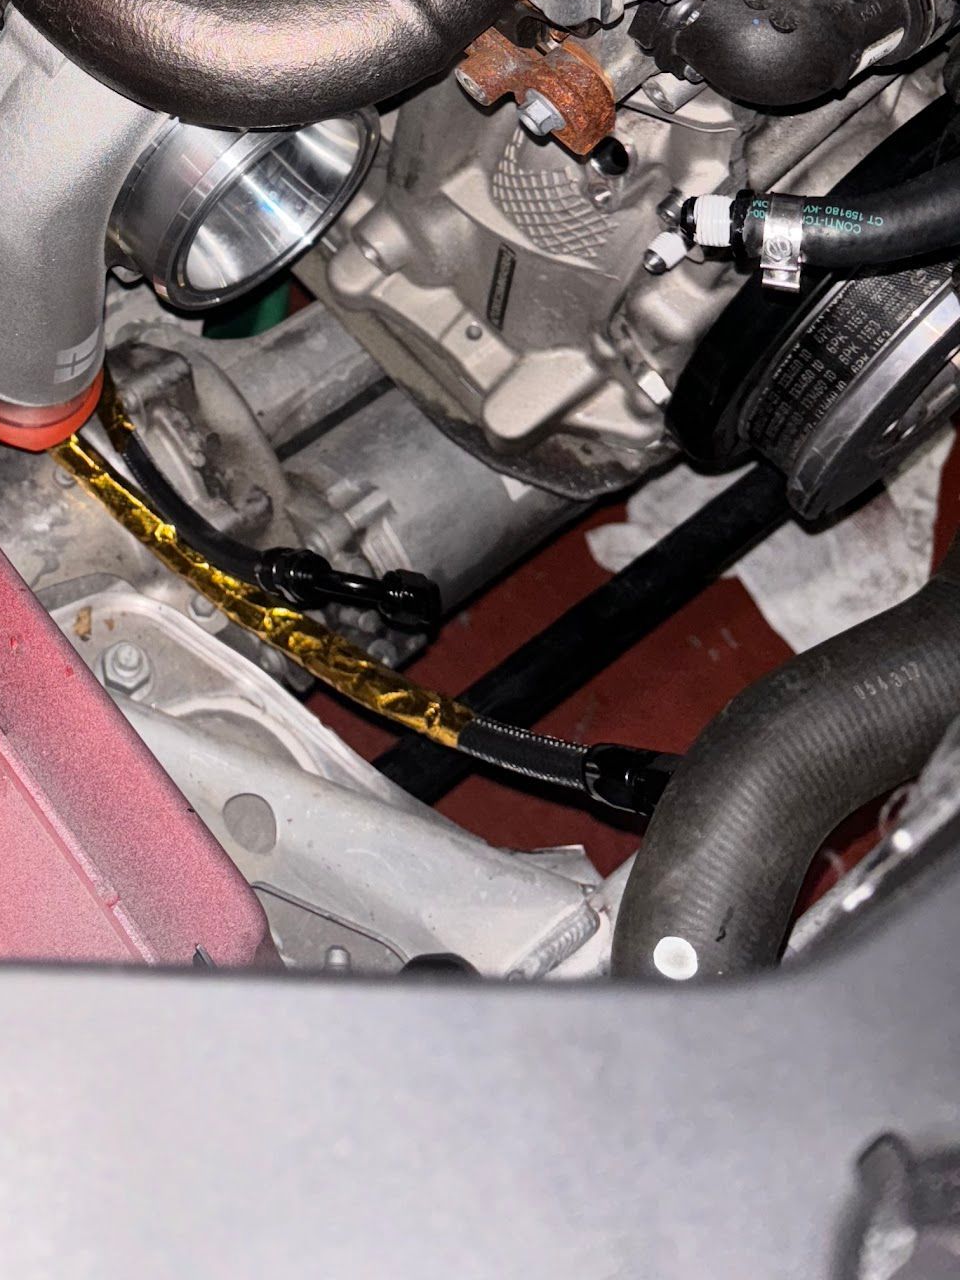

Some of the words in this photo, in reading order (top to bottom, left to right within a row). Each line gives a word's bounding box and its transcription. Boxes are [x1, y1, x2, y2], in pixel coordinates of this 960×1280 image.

[825, 206, 864, 221] 159180
[867, 216, 883, 226] CT
[826, 334, 849, 354] 6PK
[838, 343, 860, 365] 6PK
